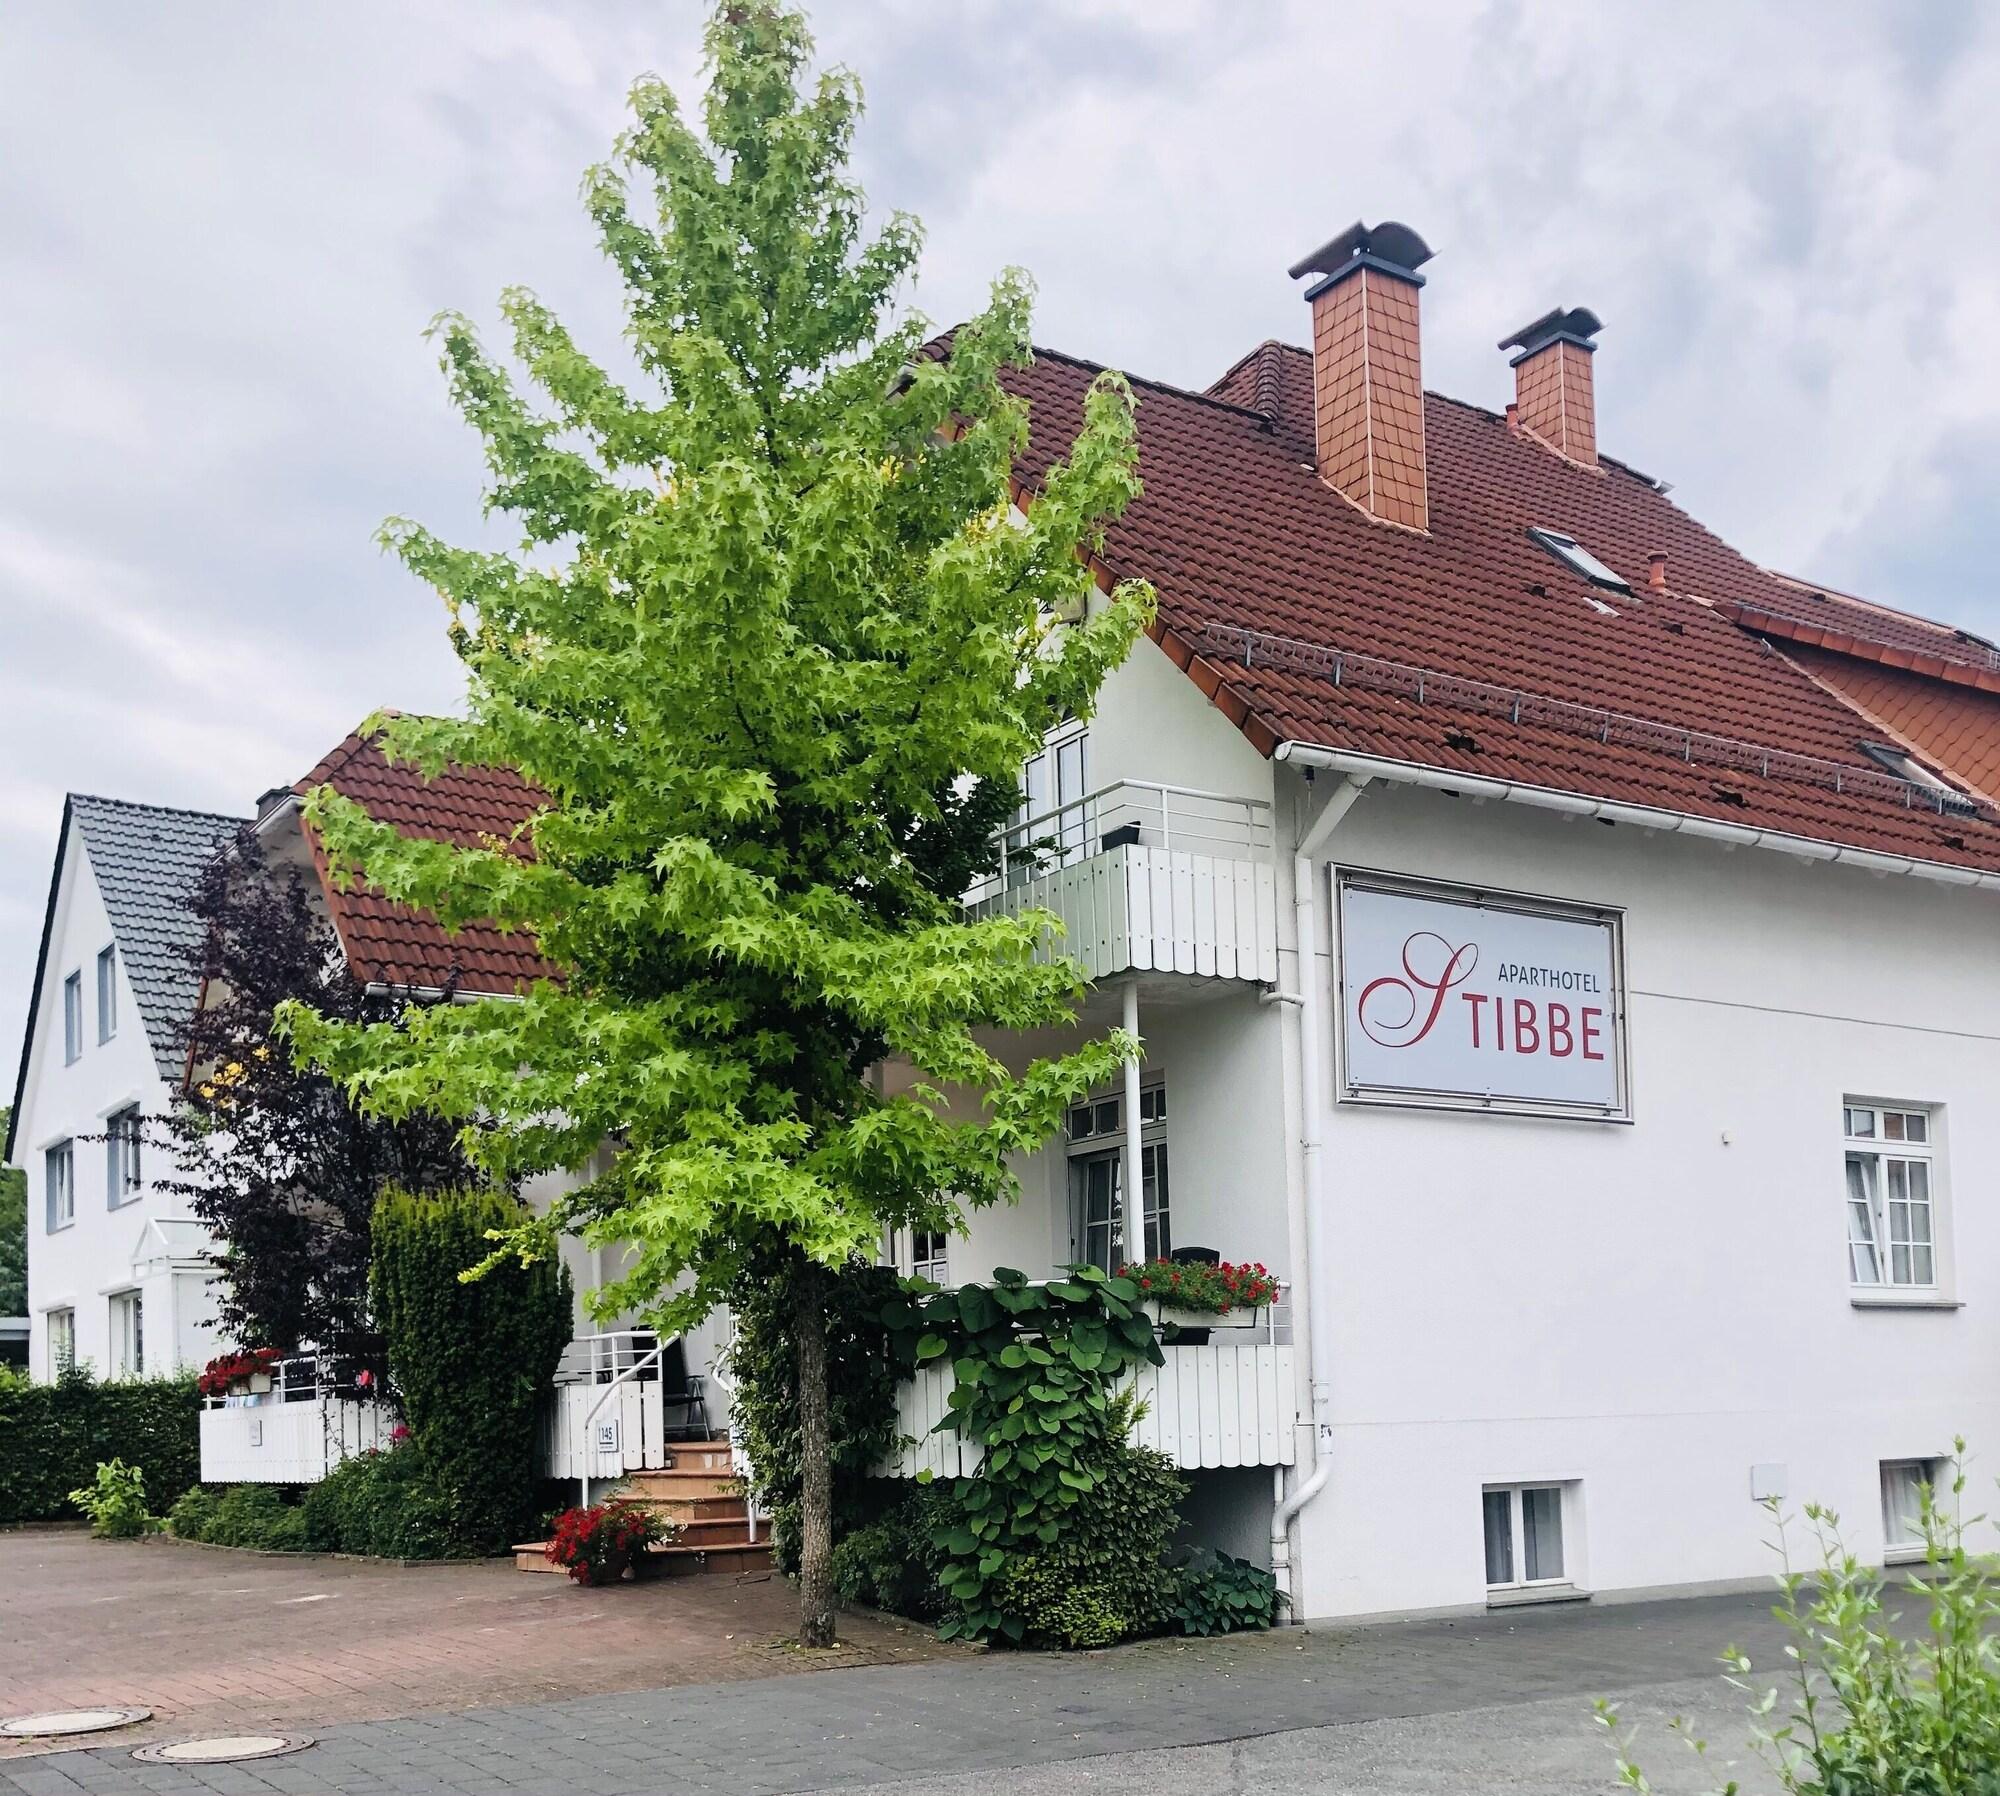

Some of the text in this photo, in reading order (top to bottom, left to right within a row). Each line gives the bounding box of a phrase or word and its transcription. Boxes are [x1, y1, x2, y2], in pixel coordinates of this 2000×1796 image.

[1498, 963, 1600, 993] APARTHOTEL
[1358, 931, 1604, 1061] STIBBE
[601, 1427, 613, 1440] 145
